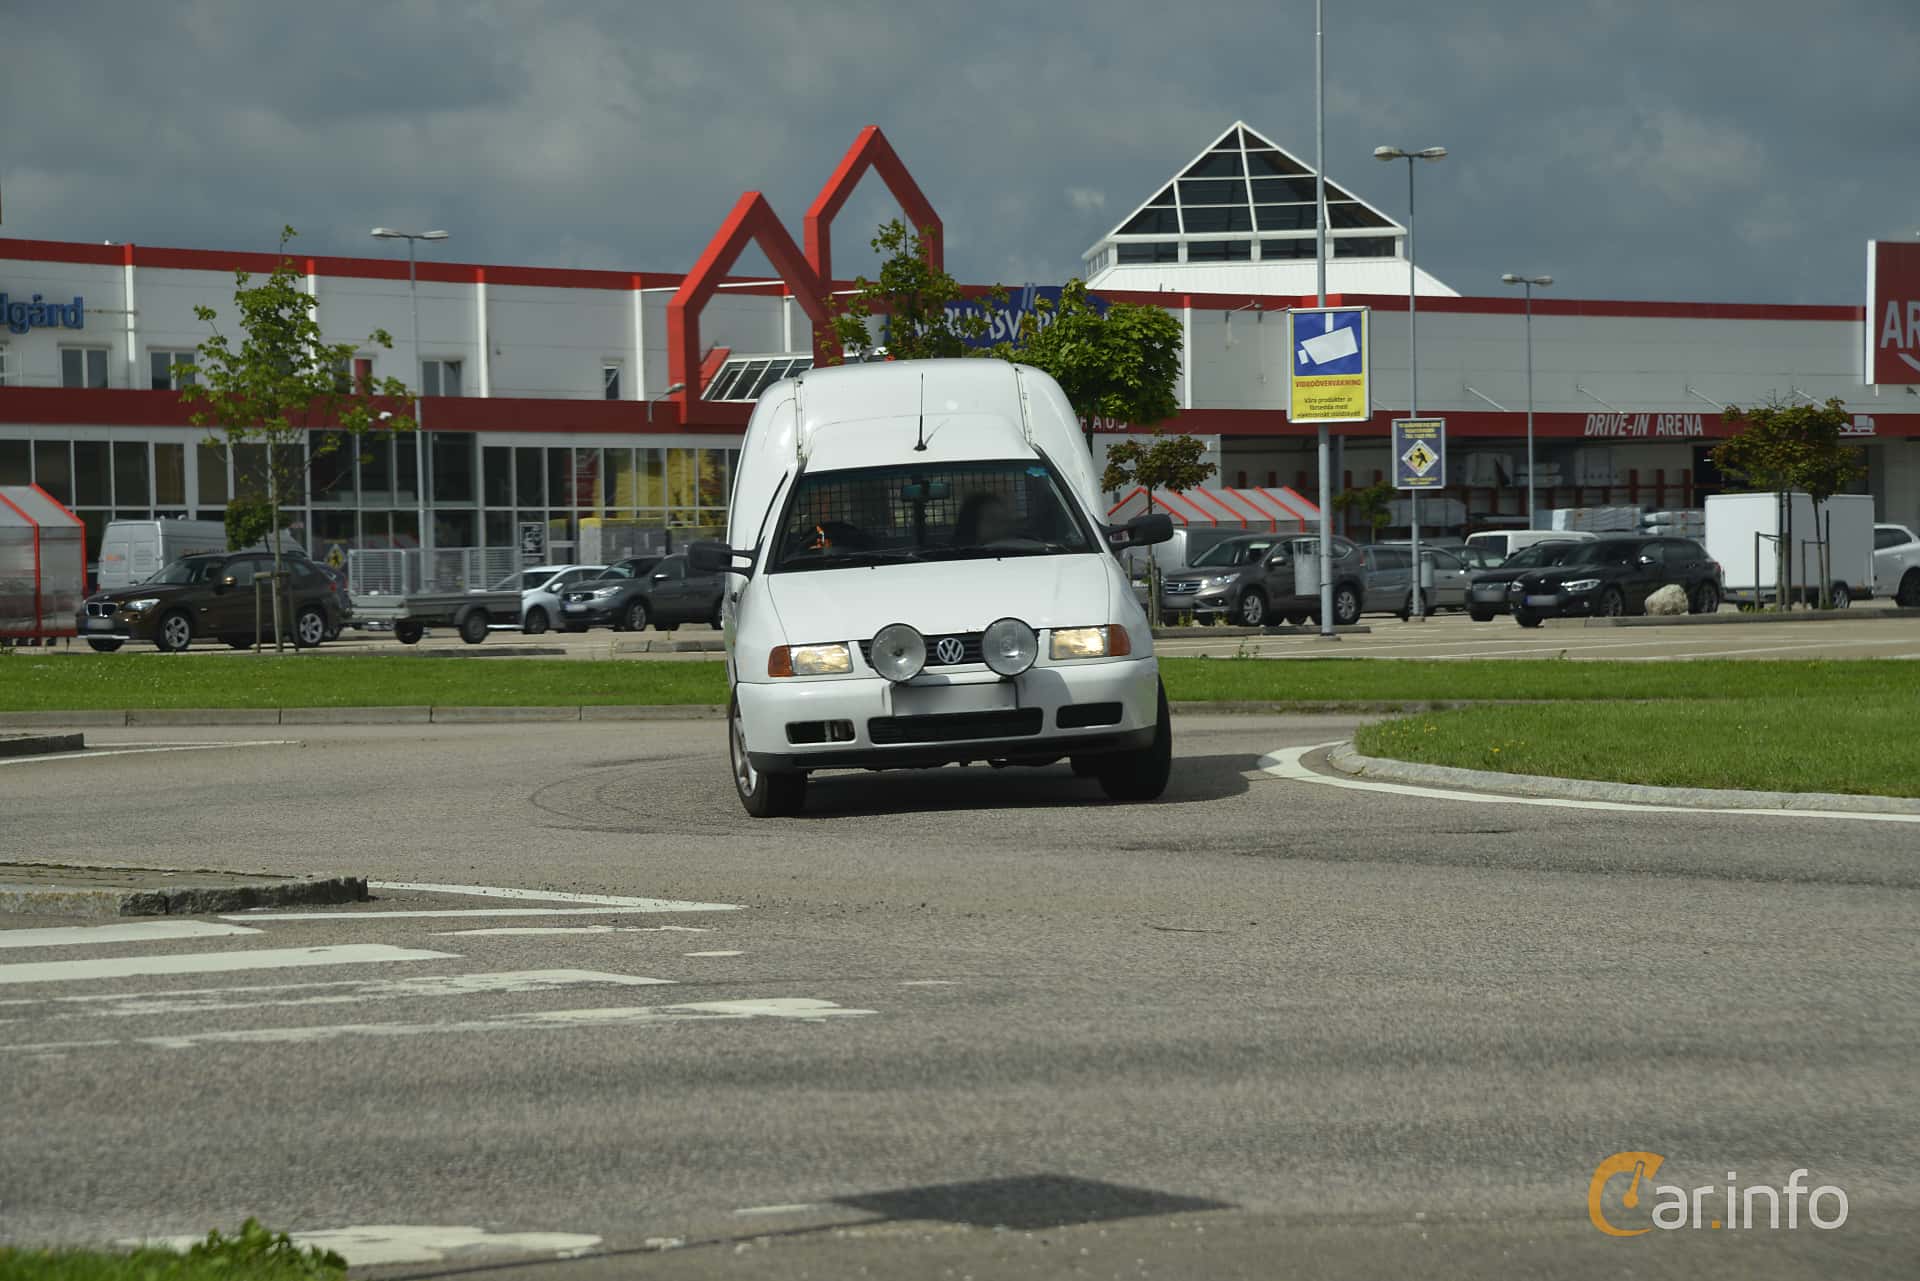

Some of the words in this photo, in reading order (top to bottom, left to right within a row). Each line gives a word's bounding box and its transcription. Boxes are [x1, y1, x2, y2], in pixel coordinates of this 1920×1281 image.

[1584, 414, 1650, 437] DRIVE-IN
[1656, 414, 1704, 436] ARENA
[937, 638, 964, 664] VW
